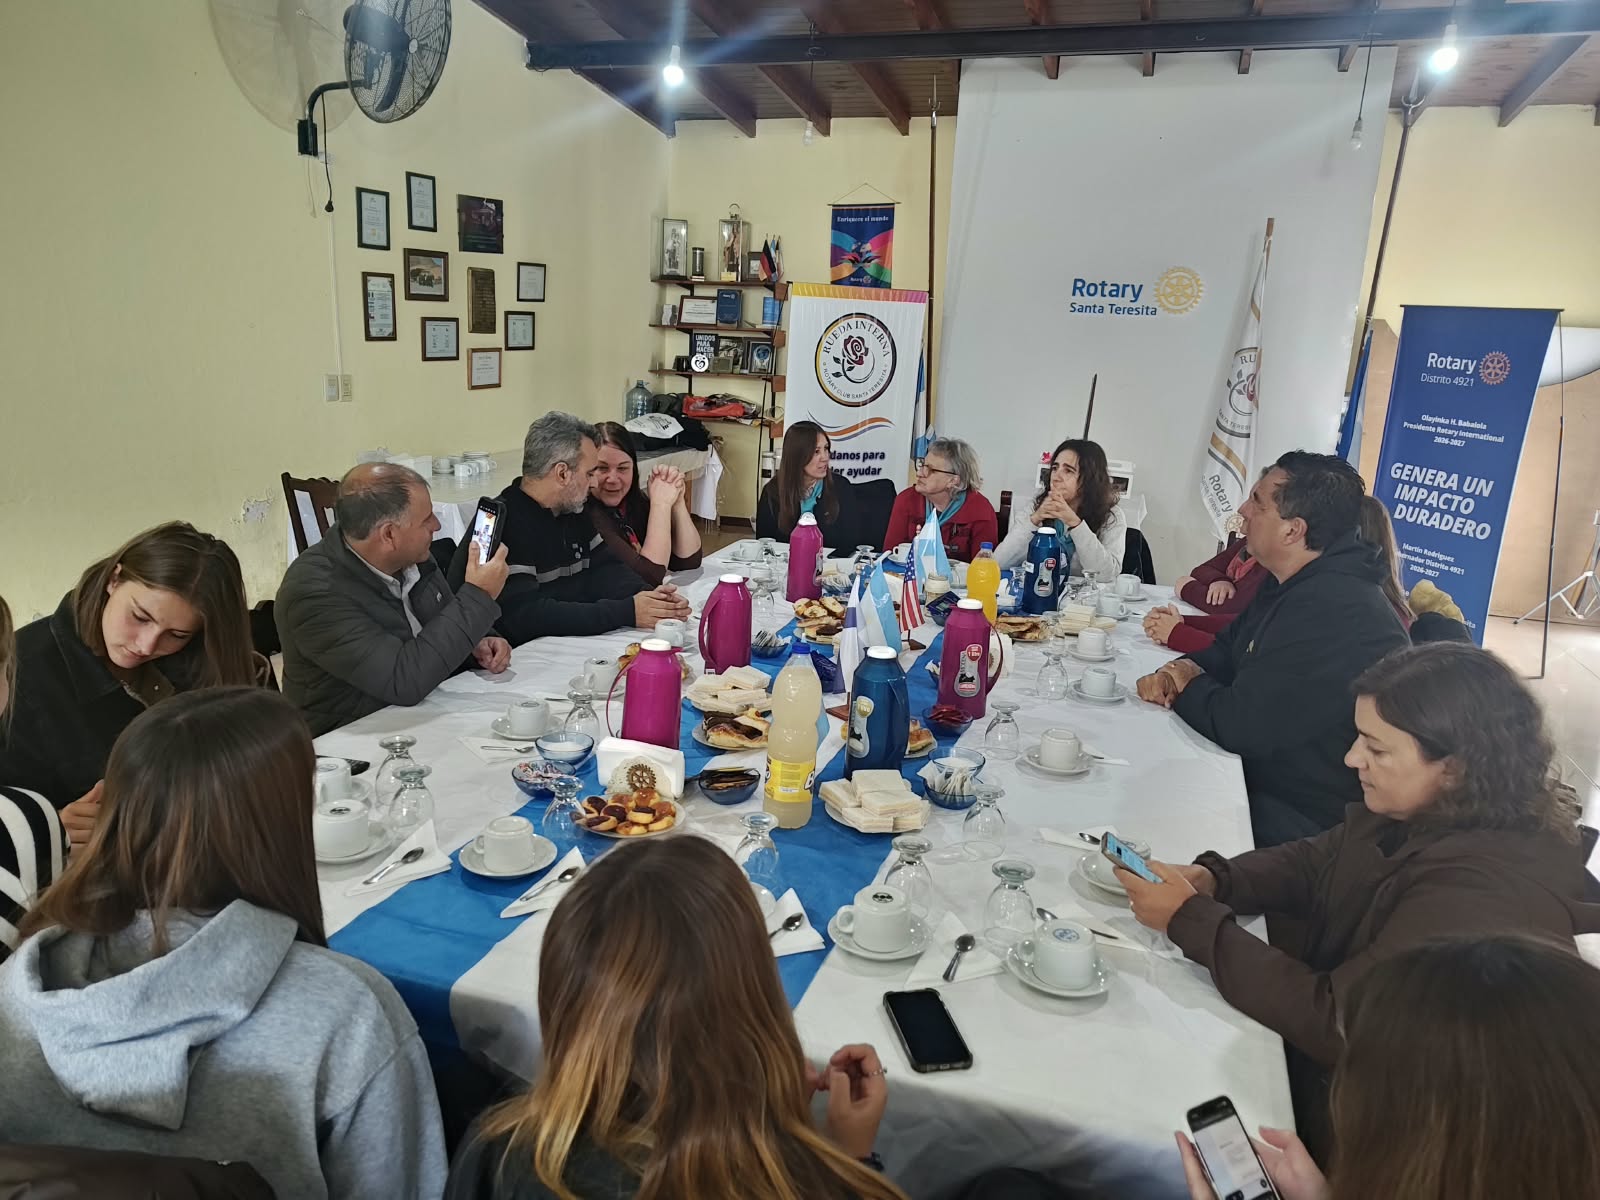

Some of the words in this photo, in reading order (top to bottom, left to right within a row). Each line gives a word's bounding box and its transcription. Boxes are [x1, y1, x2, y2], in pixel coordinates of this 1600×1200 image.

[1072, 278, 1144, 303] Rotary
[1070, 302, 1105, 314] Santa
[1108, 303, 1158, 316] Teresita
[823, 322, 853, 354] RUEDA
[855, 320, 890, 357] INTERNA
[1427, 352, 1477, 375] Rotary
[1420, 373, 1452, 385] Distrito
[1453, 376, 1474, 387] 4921
[1403, 421, 1436, 433] Presidente
[1436, 426, 1459, 437] Rotary
[1458, 430, 1505, 443] International
[862, 451, 886, 463] para
[846, 465, 882, 479] ayudar
[1390, 462, 1460, 491] GENERA
[1463, 475, 1495, 498] UN
[1208, 474, 1234, 513] Rotary
[1393, 483, 1475, 515] IMPACTO
[1393, 503, 1492, 541] DURADERO
[1425, 558, 1449, 571] Distrito
[1449, 565, 1465, 576] 4921
